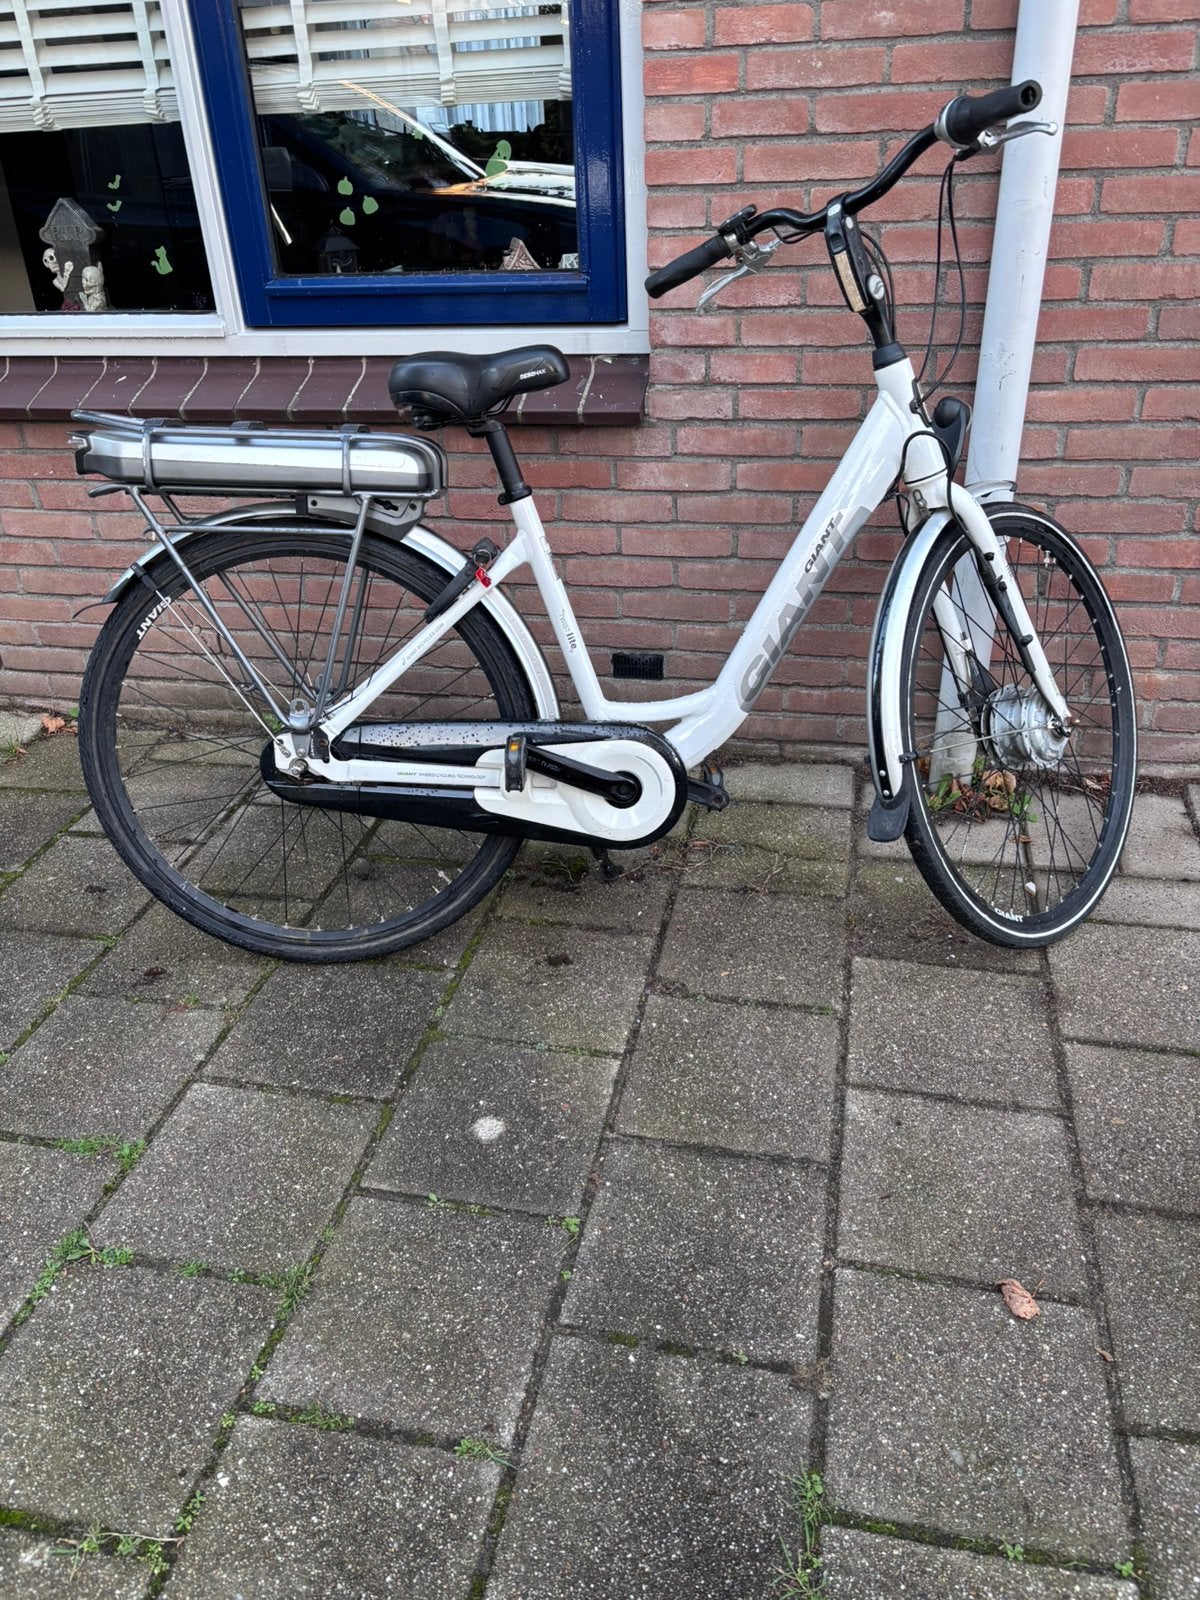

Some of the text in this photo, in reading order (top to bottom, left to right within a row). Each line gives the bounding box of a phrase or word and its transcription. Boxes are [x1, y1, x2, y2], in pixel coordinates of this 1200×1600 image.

[804, 517, 836, 574] GIANT
[136, 596, 172, 640] GIANT
[740, 511, 845, 703] GIANT
[566, 632, 577, 649] lite
[994, 907, 1024, 922] GIANT
